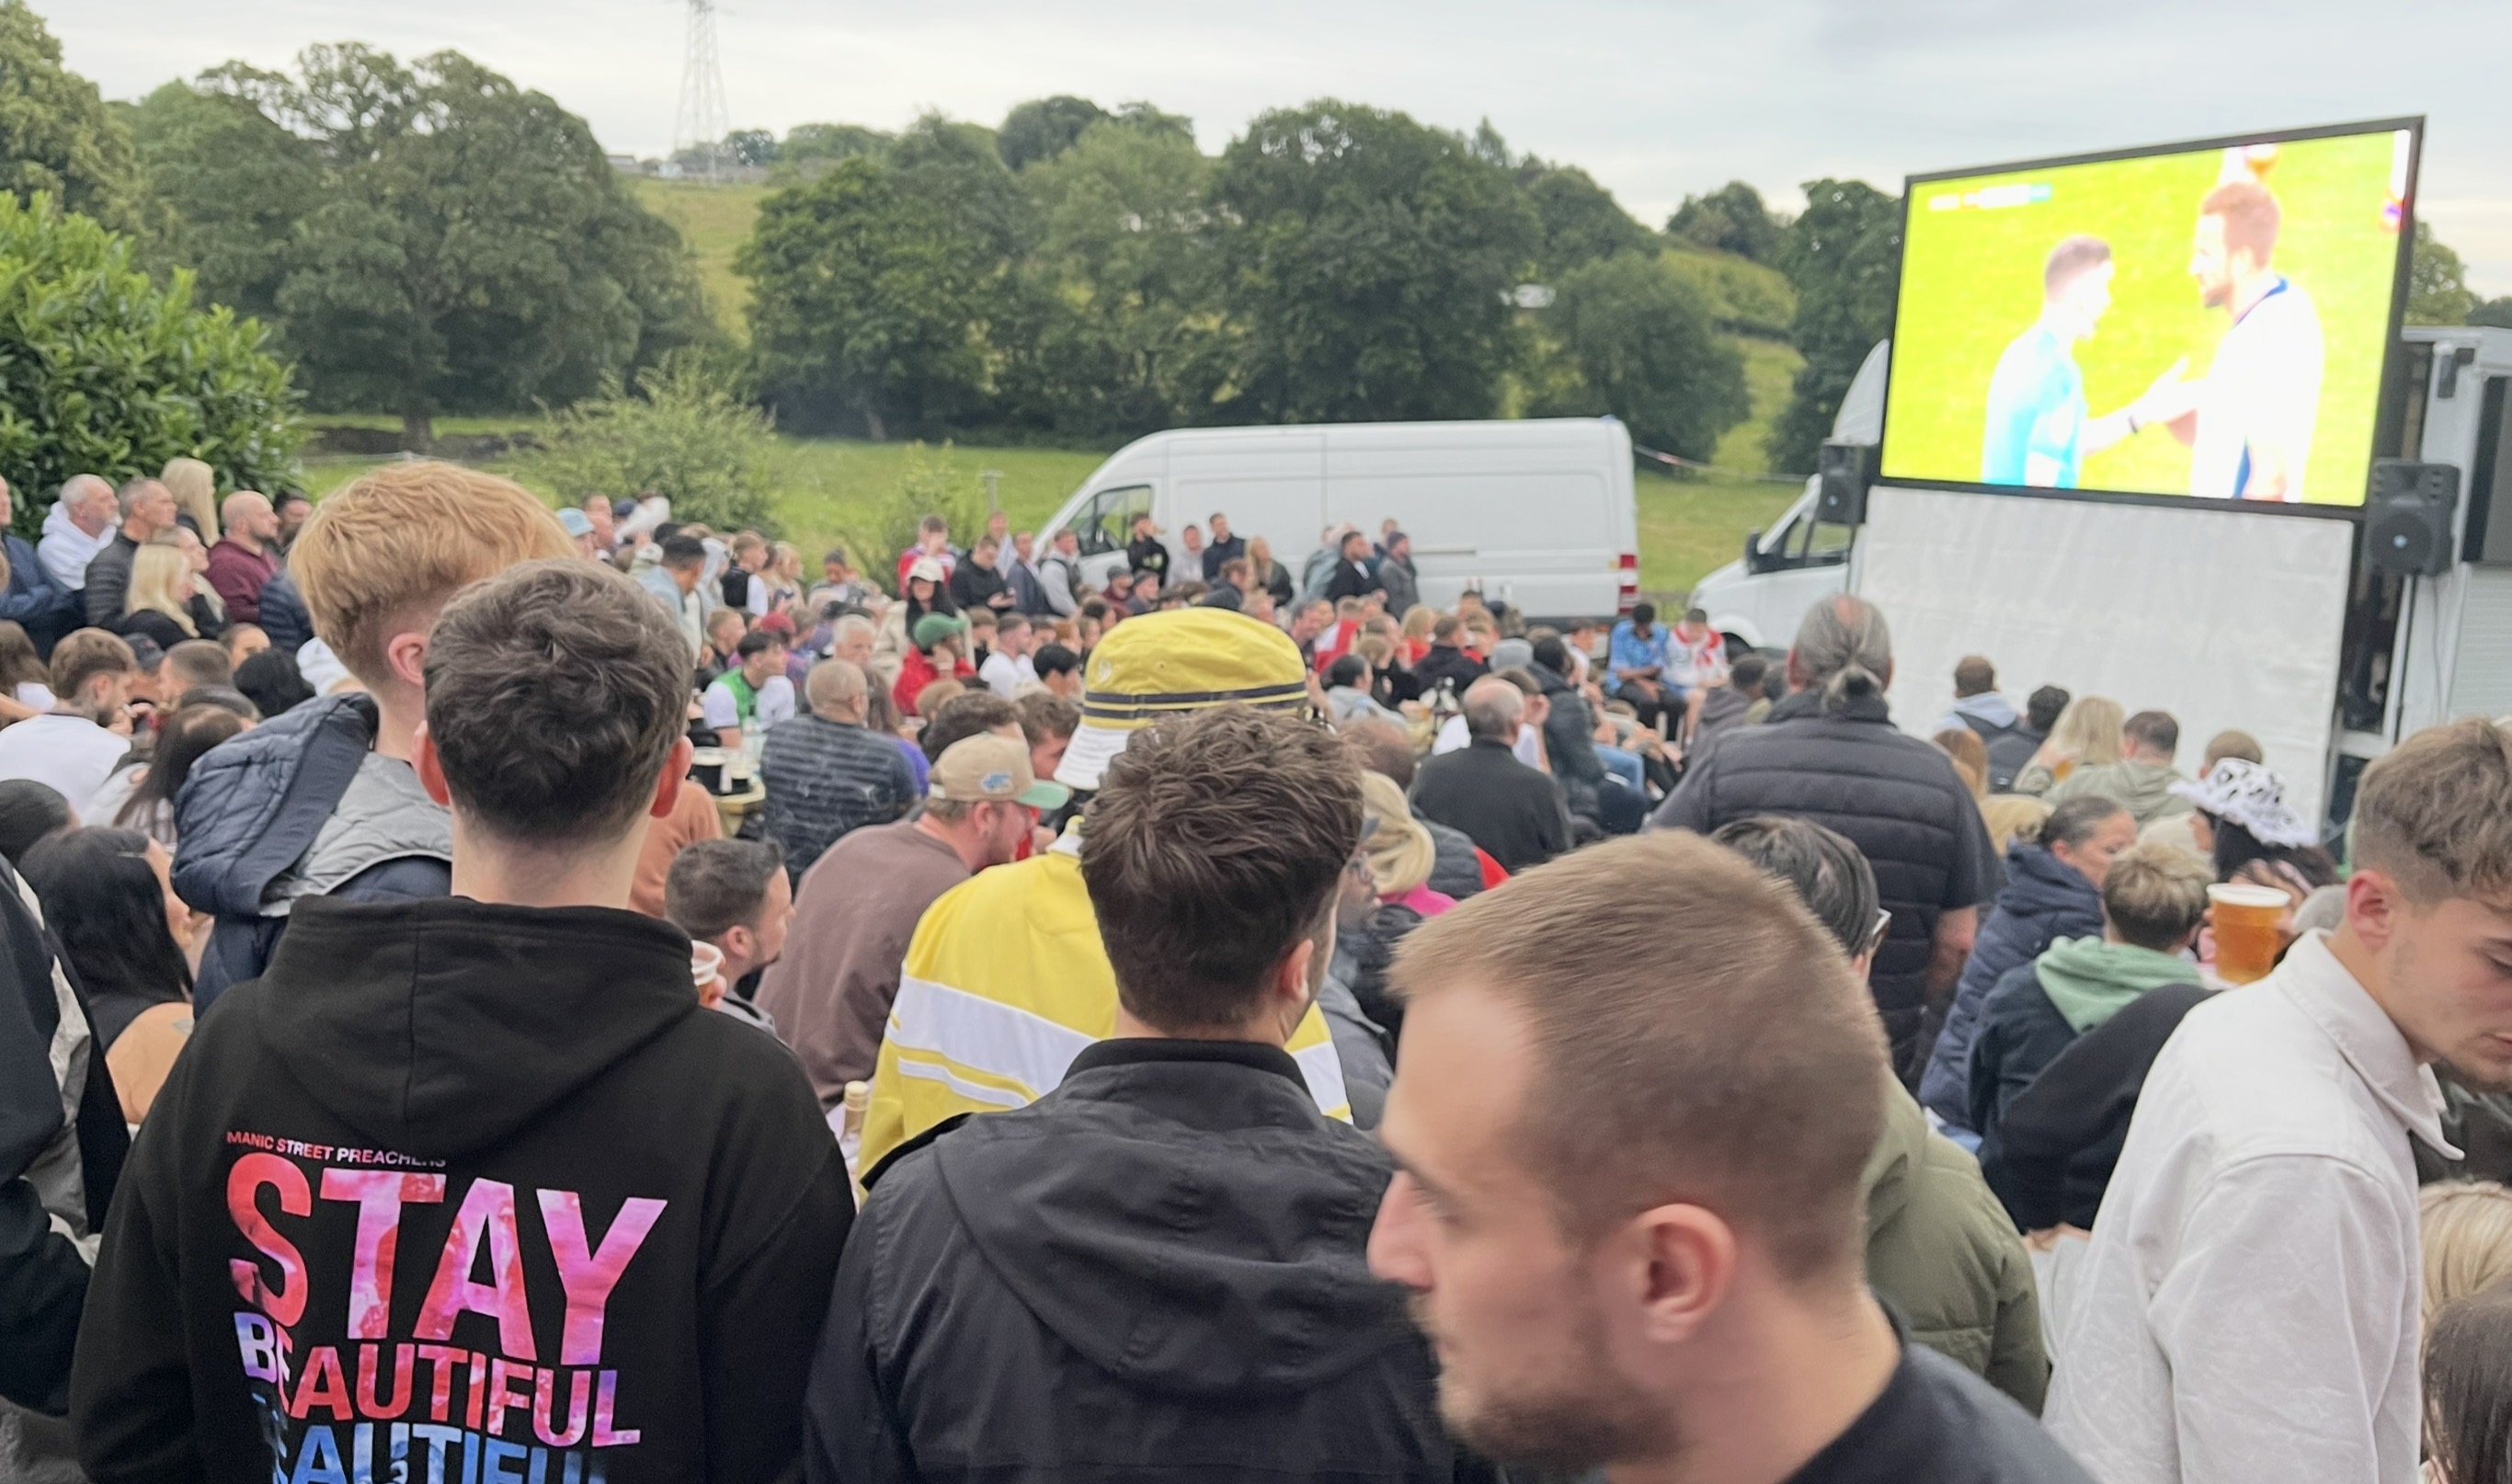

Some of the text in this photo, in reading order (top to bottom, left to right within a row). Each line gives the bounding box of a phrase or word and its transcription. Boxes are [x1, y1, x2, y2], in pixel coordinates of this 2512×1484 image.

[226, 1131, 446, 1168] MANIC STREET PREACH
[227, 1152, 668, 1365] STAY
[251, 1392, 607, 1484] AUTIF
